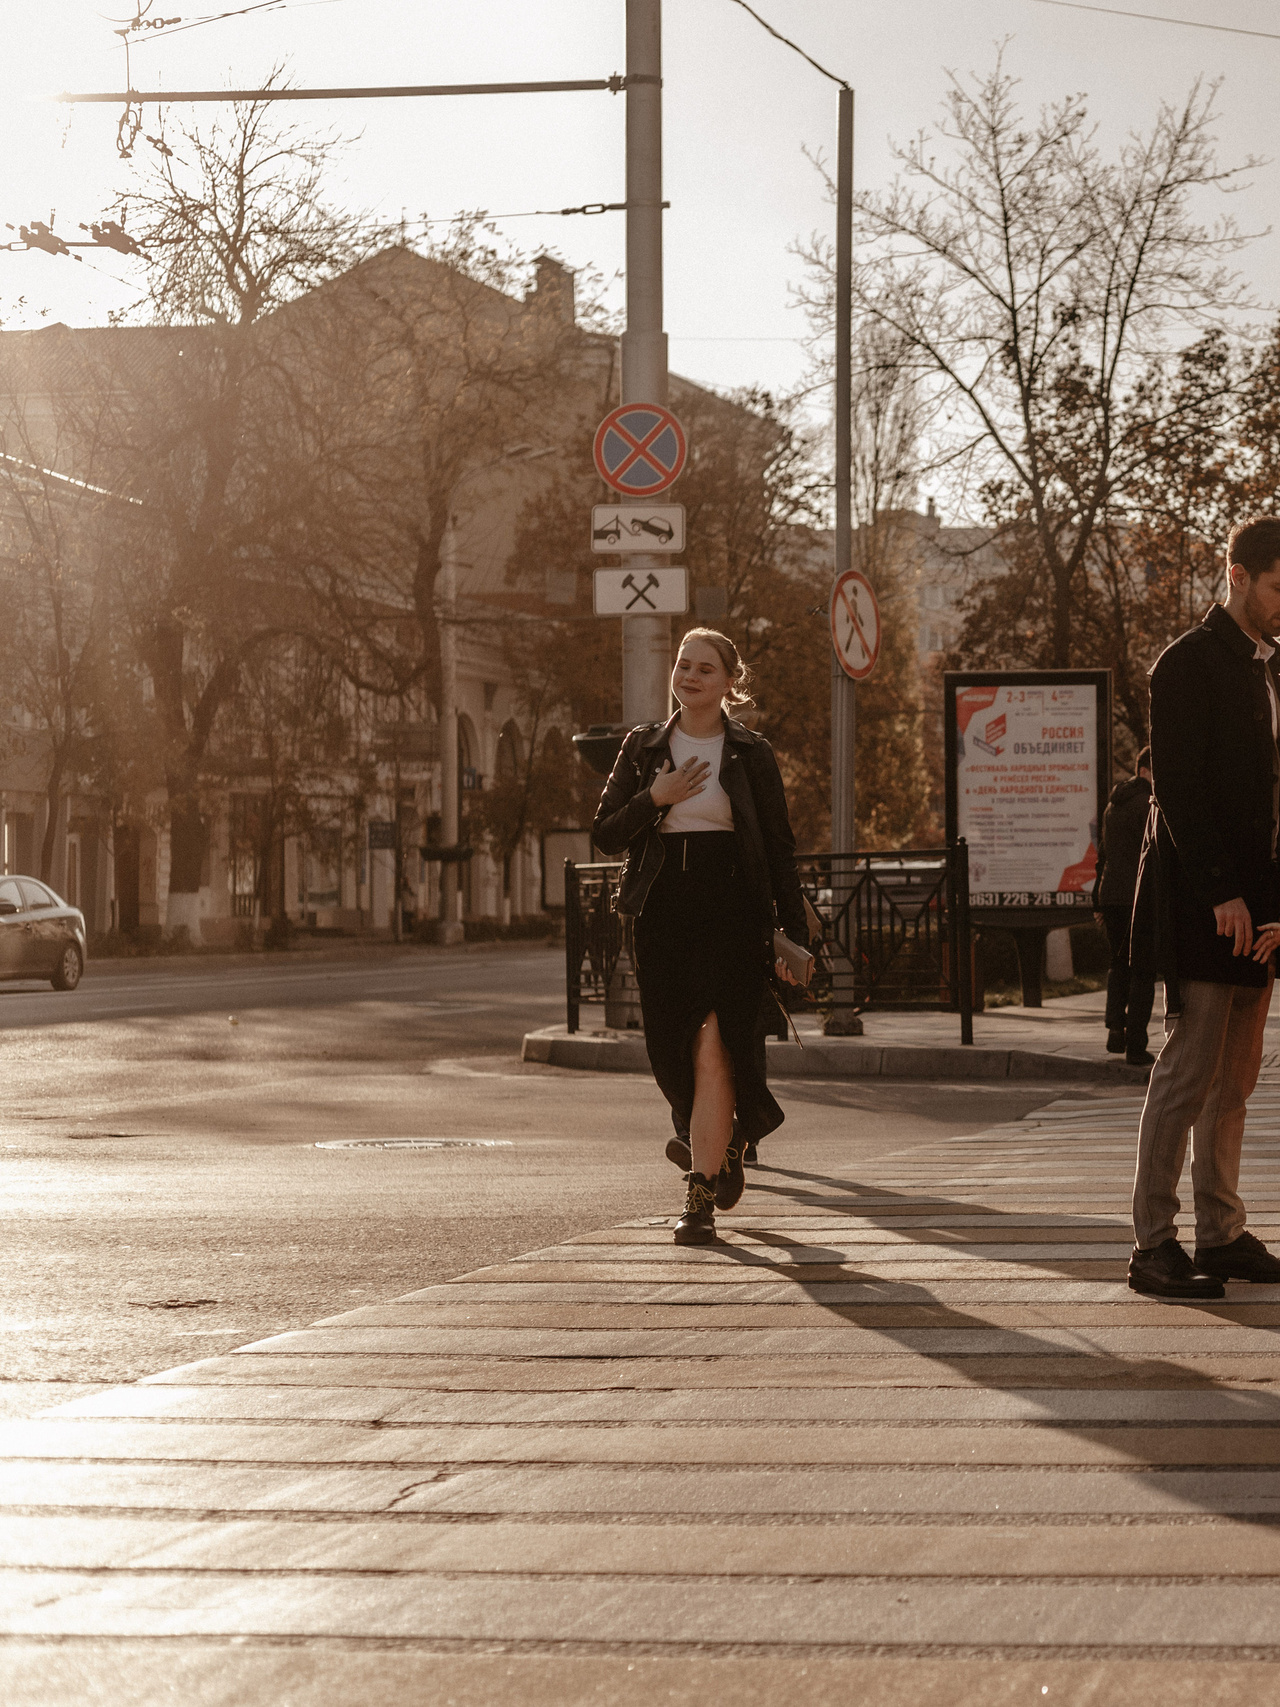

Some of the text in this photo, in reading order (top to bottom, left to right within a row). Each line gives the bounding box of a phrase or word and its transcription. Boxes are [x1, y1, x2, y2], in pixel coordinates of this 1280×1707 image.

[1042, 727, 1084, 739] РОССИЯ
[1013, 742, 1085, 755] ОБЪЕДИНЯЕТ
[1003, 892, 1074, 906] 226-26-00
